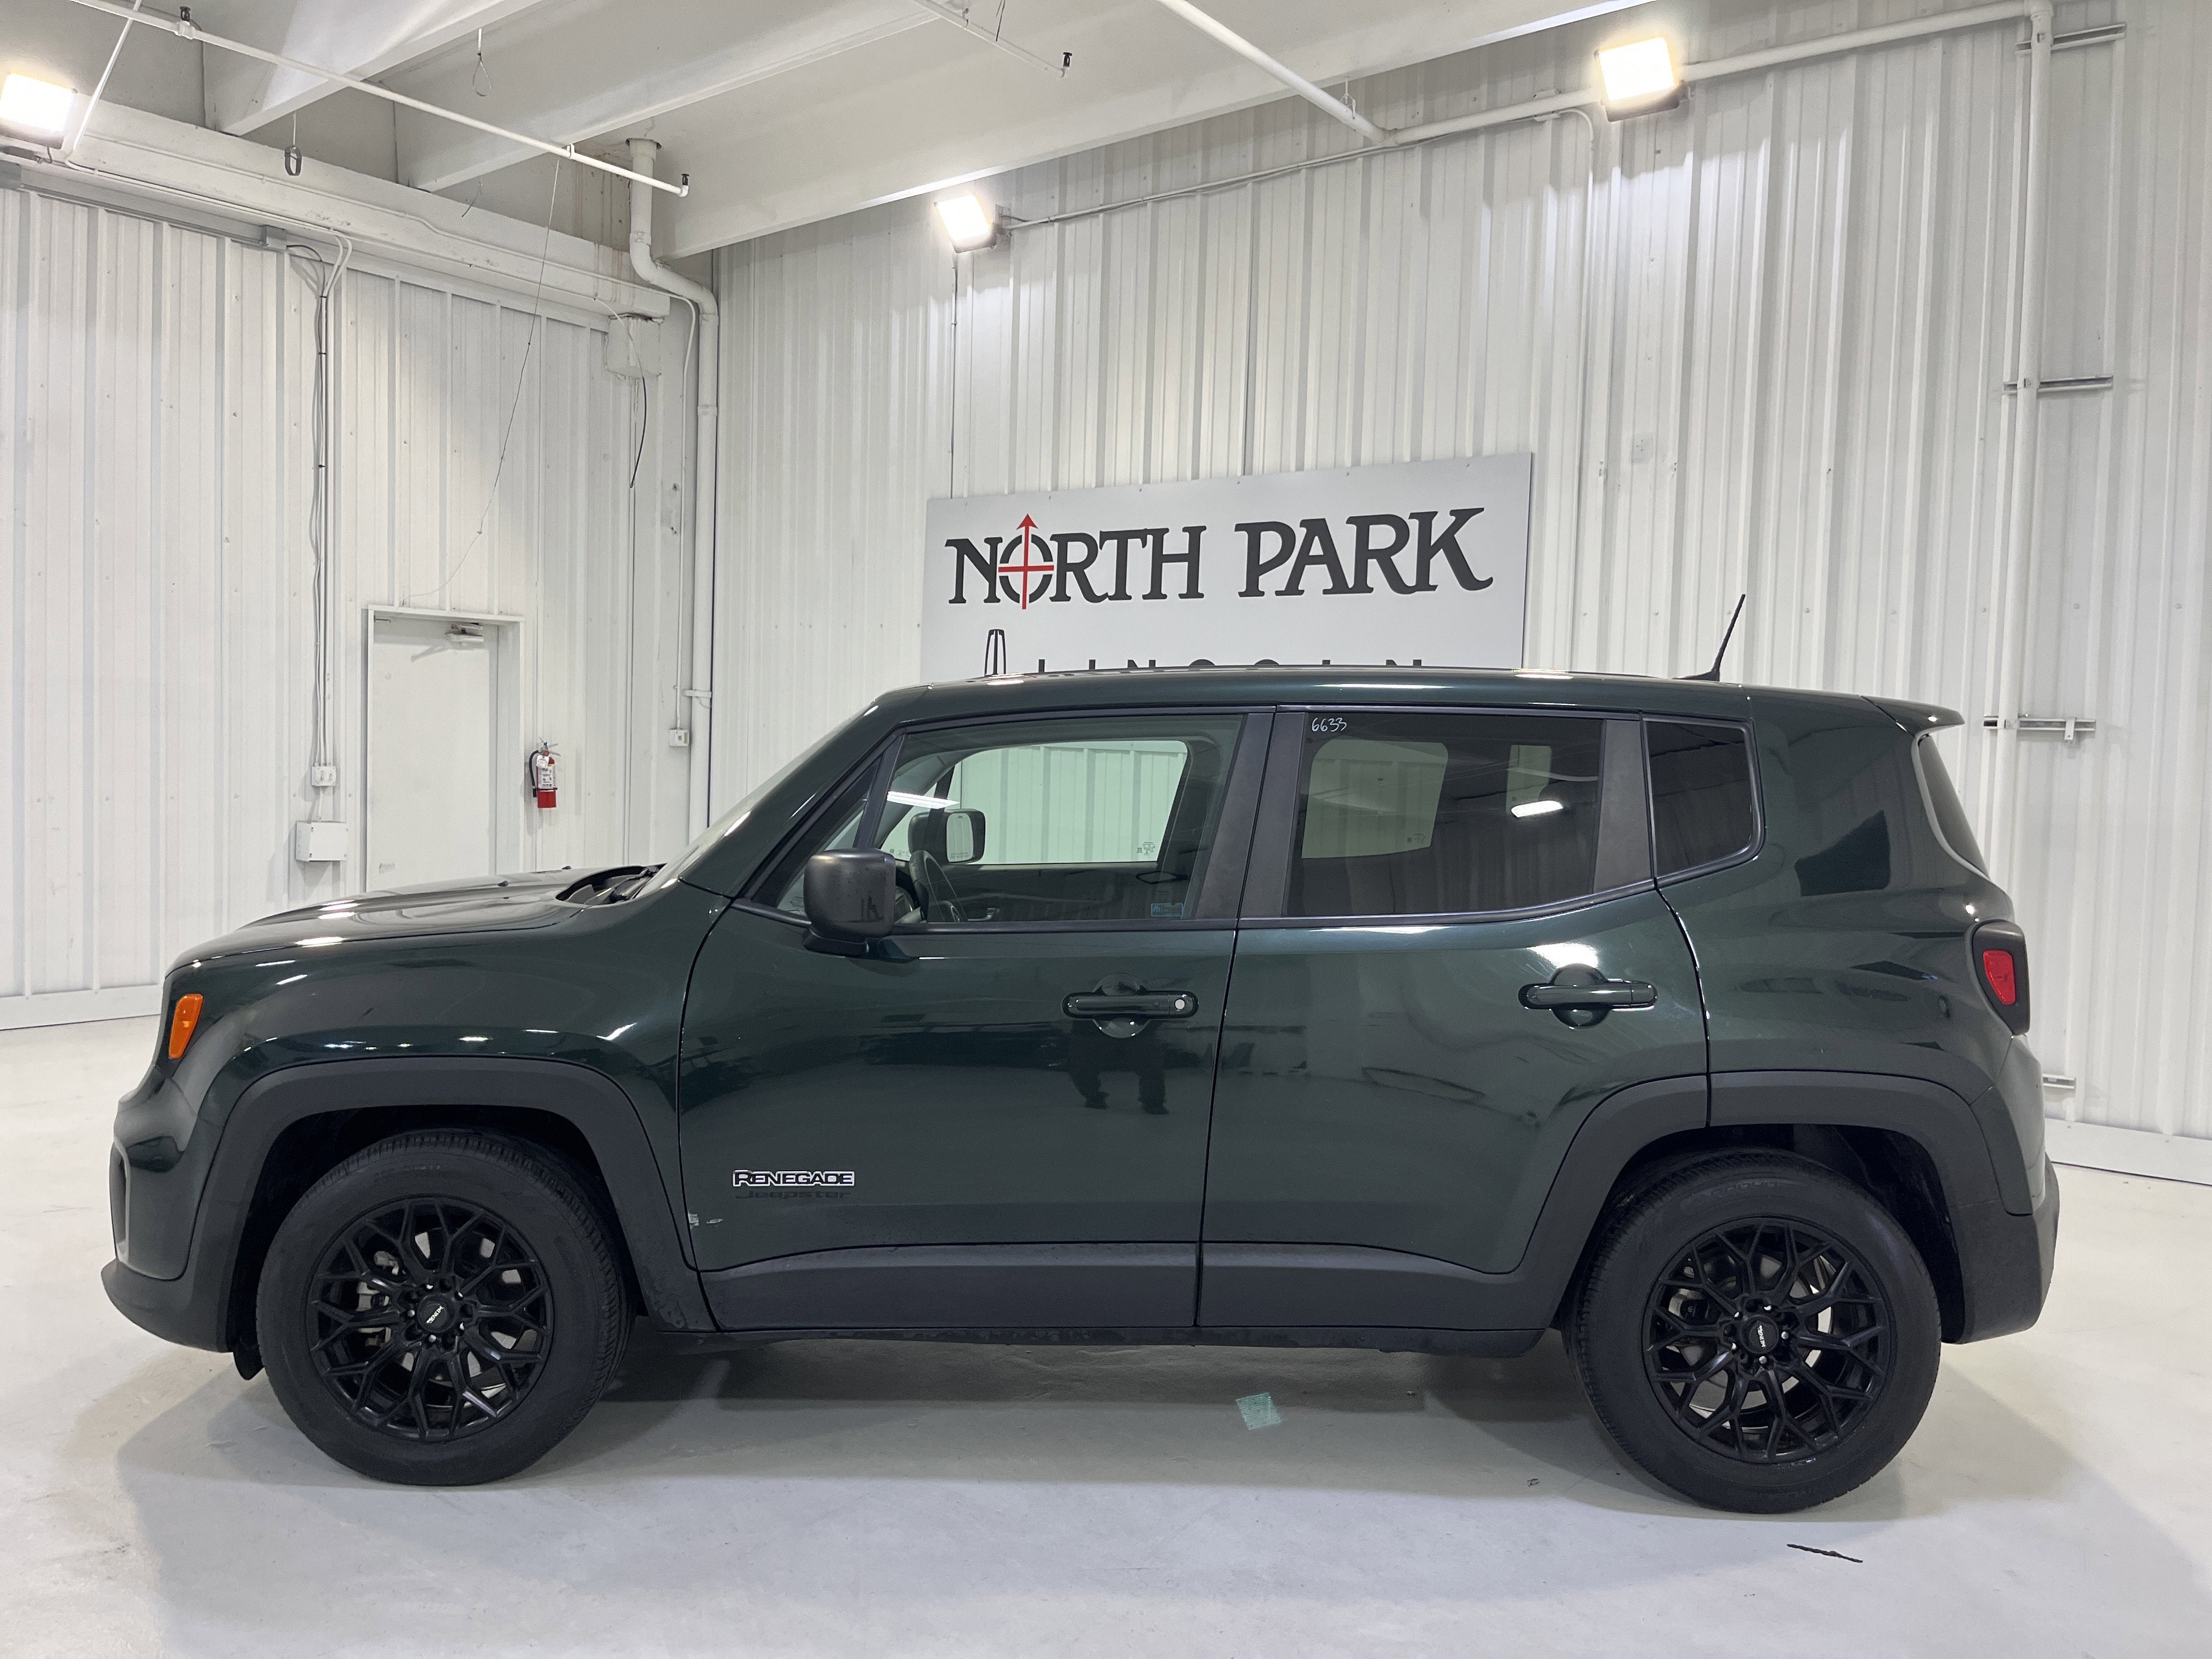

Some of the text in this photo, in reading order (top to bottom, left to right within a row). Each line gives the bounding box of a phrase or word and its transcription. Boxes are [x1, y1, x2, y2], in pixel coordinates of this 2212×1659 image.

[945, 507, 1493, 603] NORTH PARK
[1311, 717, 1347, 732] 6633
[732, 1169, 855, 1187] RENEGADE
